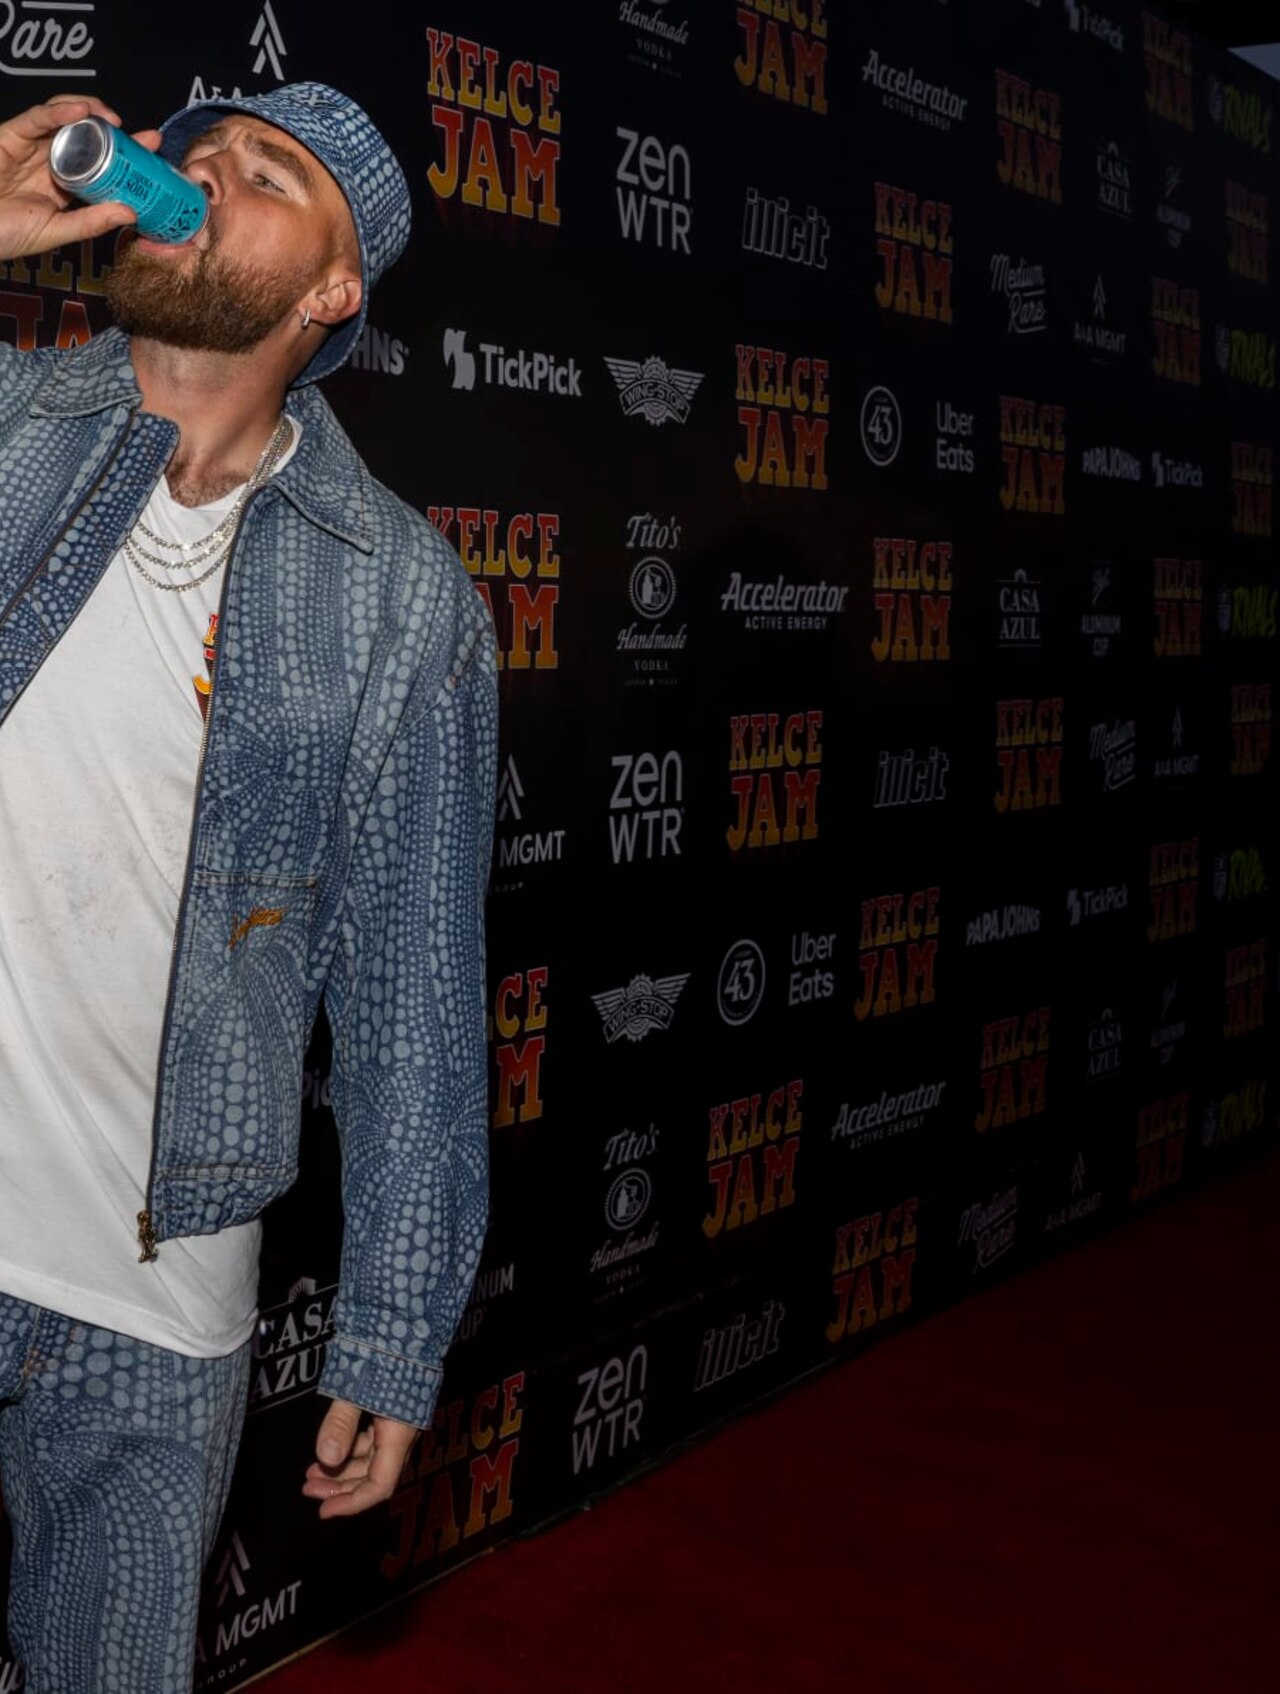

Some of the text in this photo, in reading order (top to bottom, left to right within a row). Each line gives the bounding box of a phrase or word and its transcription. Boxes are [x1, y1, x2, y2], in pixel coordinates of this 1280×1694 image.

[426, 27, 561, 135] KELCE
[733, 7, 829, 116] JAM
[862, 49, 968, 121] Accelerator
[426, 104, 561, 227] JAM
[616, 126, 692, 200] zen
[995, 119, 1063, 206] JAM
[616, 186, 692, 255] WTR
[873, 181, 954, 254] KELCE
[874, 238, 954, 325] JAM
[352, 324, 406, 376] HNS
[479, 343, 583, 397] TickPick
[735, 343, 830, 414] KELCE
[734, 406, 830, 491] JAM
[868, 404, 894, 445] 43
[936, 401, 975, 436] Uber
[998, 395, 1066, 450] KELCE
[936, 438, 975, 473] Eats
[999, 446, 1065, 514] JAM
[626, 512, 682, 549] Tito's
[720, 571, 849, 613] Accelerator
[872, 537, 954, 592] KELCE
[744, 615, 829, 631] ACTIVE ENERGY
[871, 593, 952, 662] JAM
[998, 616, 1041, 640] AZUL
[999, 587, 1041, 613] CASA
[728, 710, 824, 771] KELCE
[995, 697, 1064, 746] KELCE
[609, 750, 683, 810] zen
[725, 769, 822, 852] JAM
[992, 746, 1064, 814] JAM
[499, 829, 567, 868] MGMT
[609, 808, 683, 864] WTR
[791, 930, 837, 966] Uber
[858, 886, 941, 950] KELCE
[965, 909, 1001, 946] PAPA
[724, 958, 756, 1003] 43
[788, 968, 836, 1006] Eats
[852, 939, 939, 1022] JAM
[706, 1079, 804, 1161] KELCE
[830, 1081, 947, 1142] Accelerator
[974, 1054, 1049, 1134] JAM
[603, 1122, 661, 1171] Tito's
[702, 1136, 801, 1239] JAM
[832, 1196, 920, 1276] KELCE
[455, 1308, 485, 1343] UP
[823, 1248, 917, 1343] JAM
[250, 1340, 327, 1402] AZU
[573, 1345, 649, 1427] zen
[402, 1370, 525, 1485] ELCE
[572, 1398, 644, 1476] WTR
[381, 1437, 519, 1579] JAM
[215, 1579, 303, 1656] MGMT
